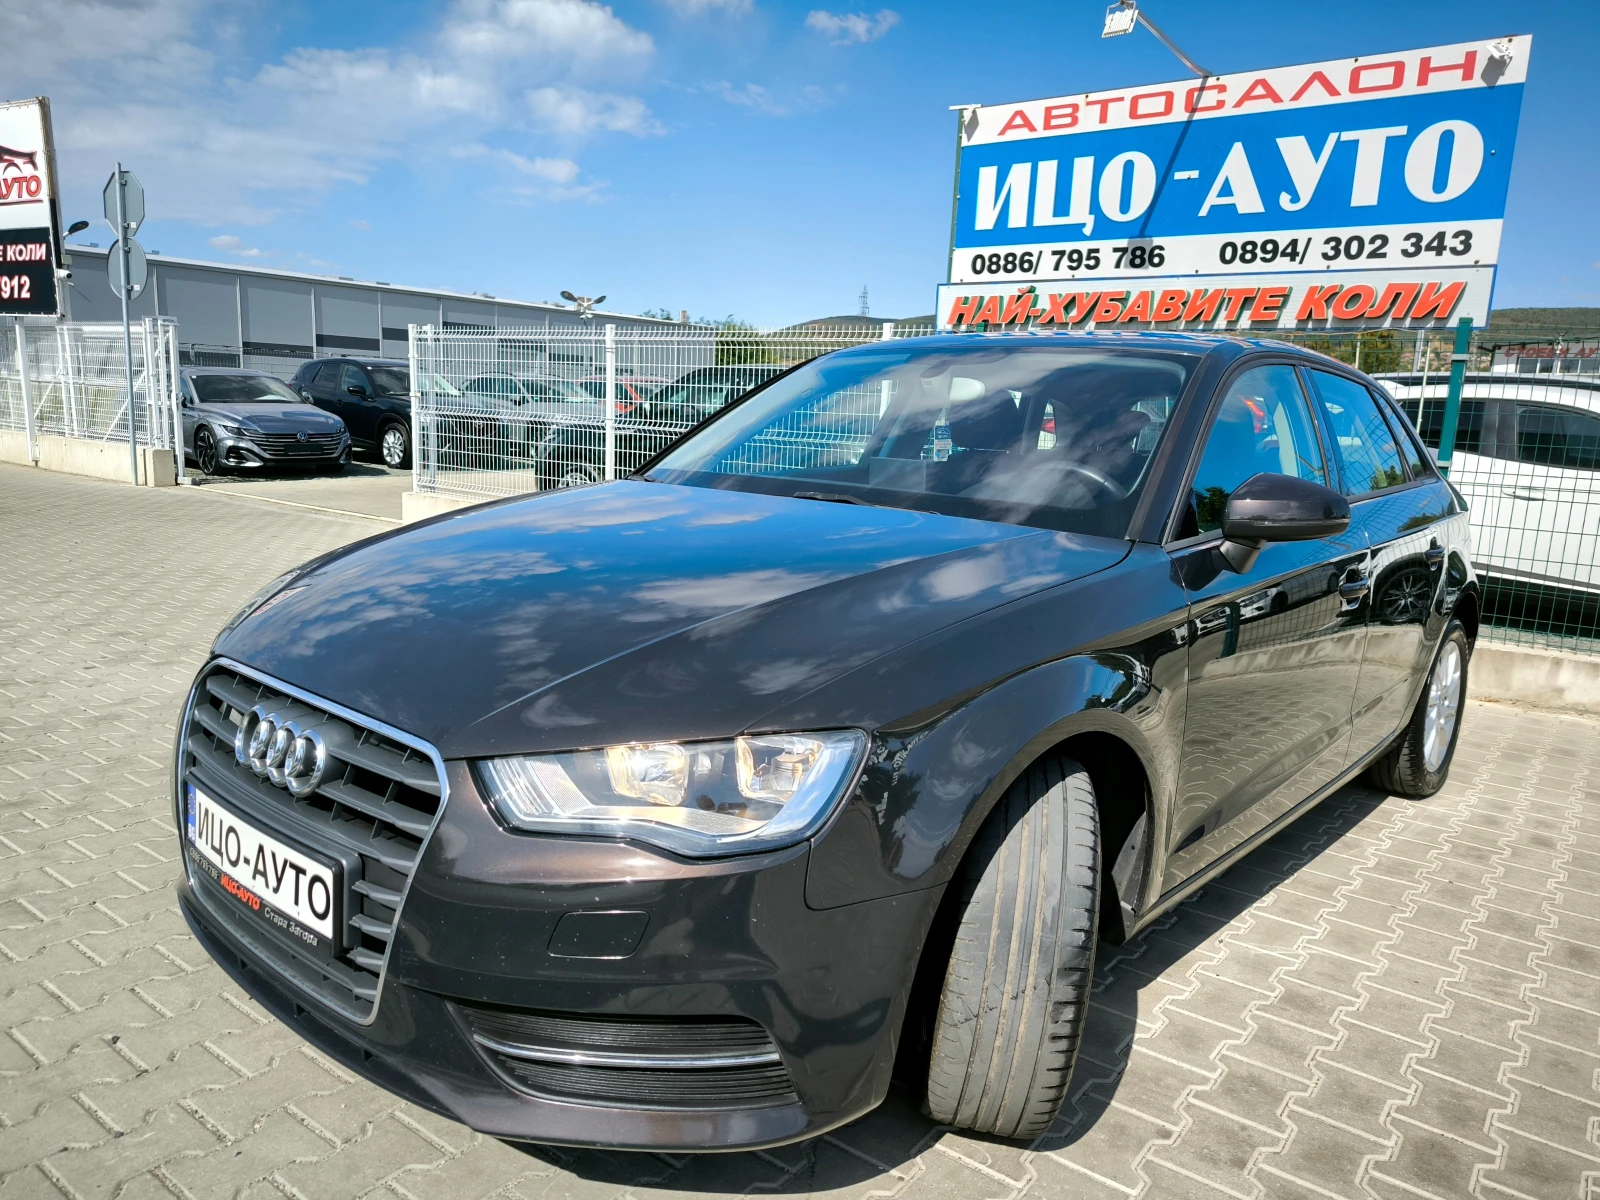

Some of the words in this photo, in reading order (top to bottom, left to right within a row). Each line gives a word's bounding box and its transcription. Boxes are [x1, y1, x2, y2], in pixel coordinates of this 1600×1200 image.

[997, 50, 1477, 136] АВТОСАЛОН
[6, 243, 47, 262] КОЛИ
[971, 250, 1042, 275] 0886/
[1050, 249, 1100, 271] 795
[1112, 244, 1166, 269] 786
[1218, 237, 1312, 265] 0894/
[1321, 234, 1389, 260] 302
[1400, 229, 1473, 258] 343
[0, 274, 31, 299] 912
[946, 284, 1293, 326] НАЙ-ХУБАВИТЕ
[1294, 280, 1469, 321] КОЛИ
[1573, 347, 1600, 358] АУ
[198, 801, 331, 922] ИЦО-АУТО
[221, 873, 261, 910] ИЦО-АУТО
[264, 907, 288, 929] Стара
[289, 921, 319, 947] Загора
